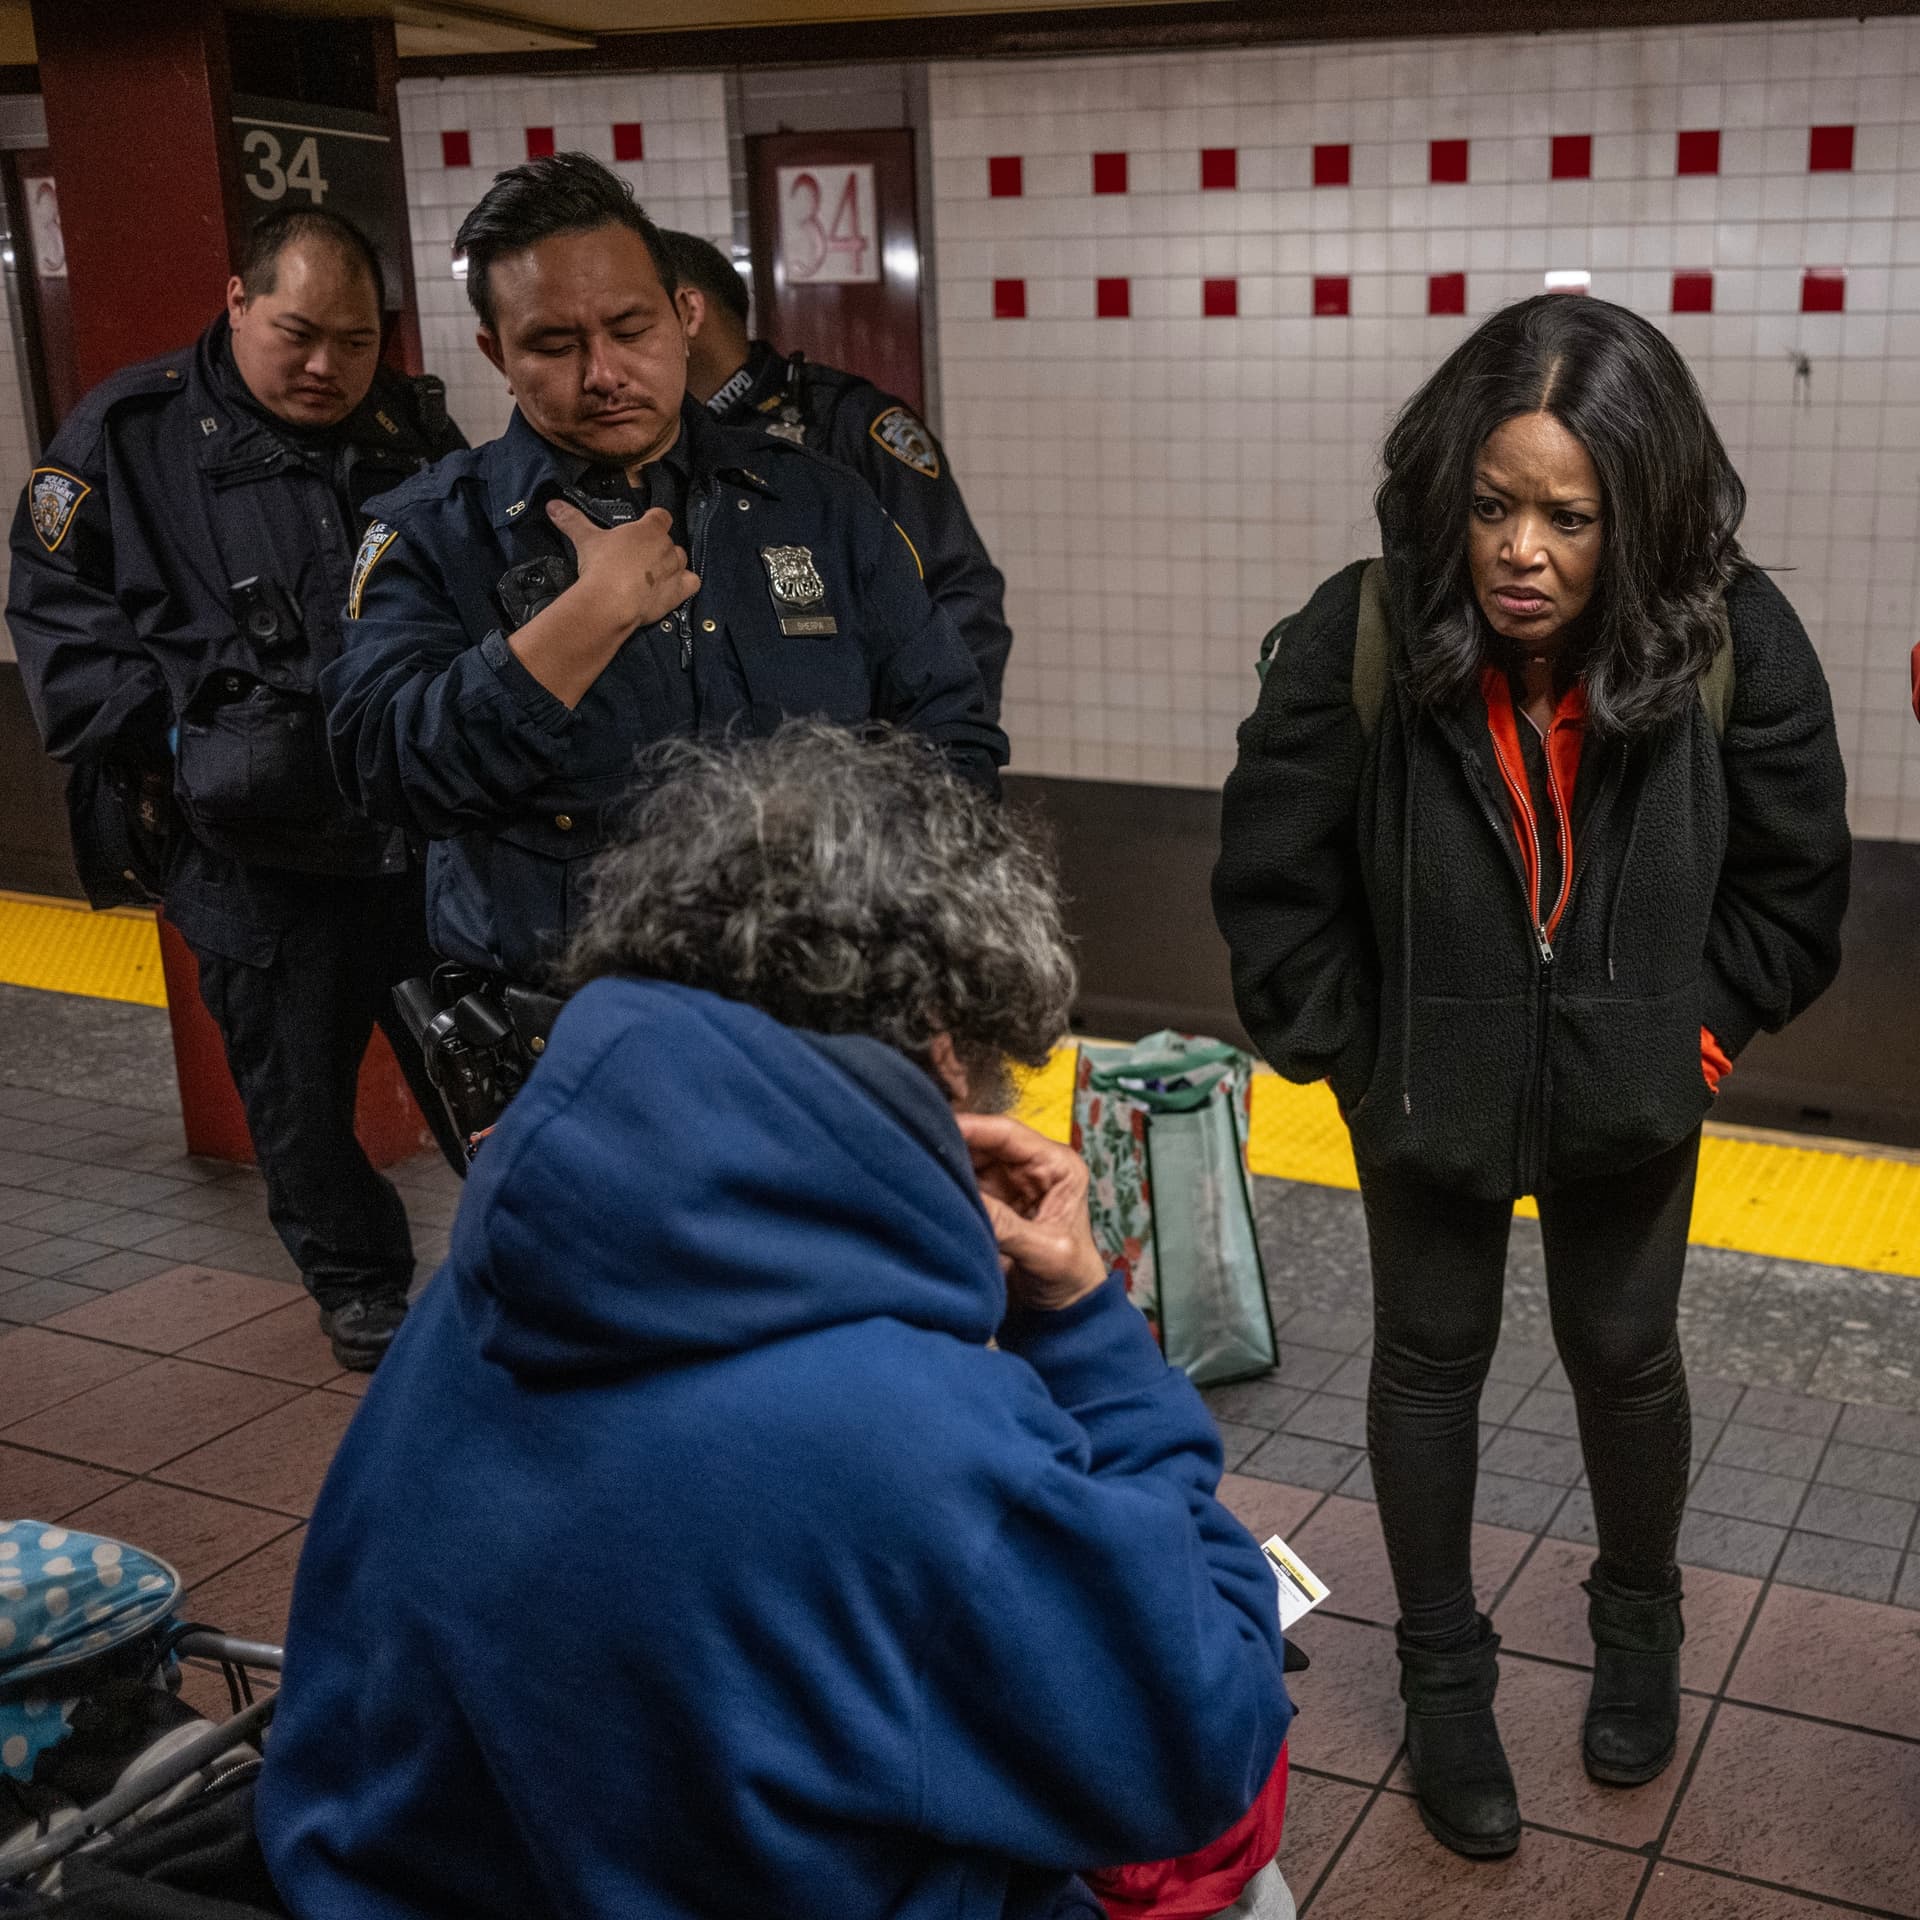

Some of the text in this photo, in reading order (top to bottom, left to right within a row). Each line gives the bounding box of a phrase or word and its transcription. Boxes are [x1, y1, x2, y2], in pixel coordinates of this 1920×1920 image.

[243, 130, 328, 204] 34
[788, 173, 868, 277] 34
[706, 370, 753, 415] NYPD
[34, 483, 75, 501] DEPARTMENT
[44, 475, 72, 489] POLICE
[797, 621, 825, 632] SHERPA
